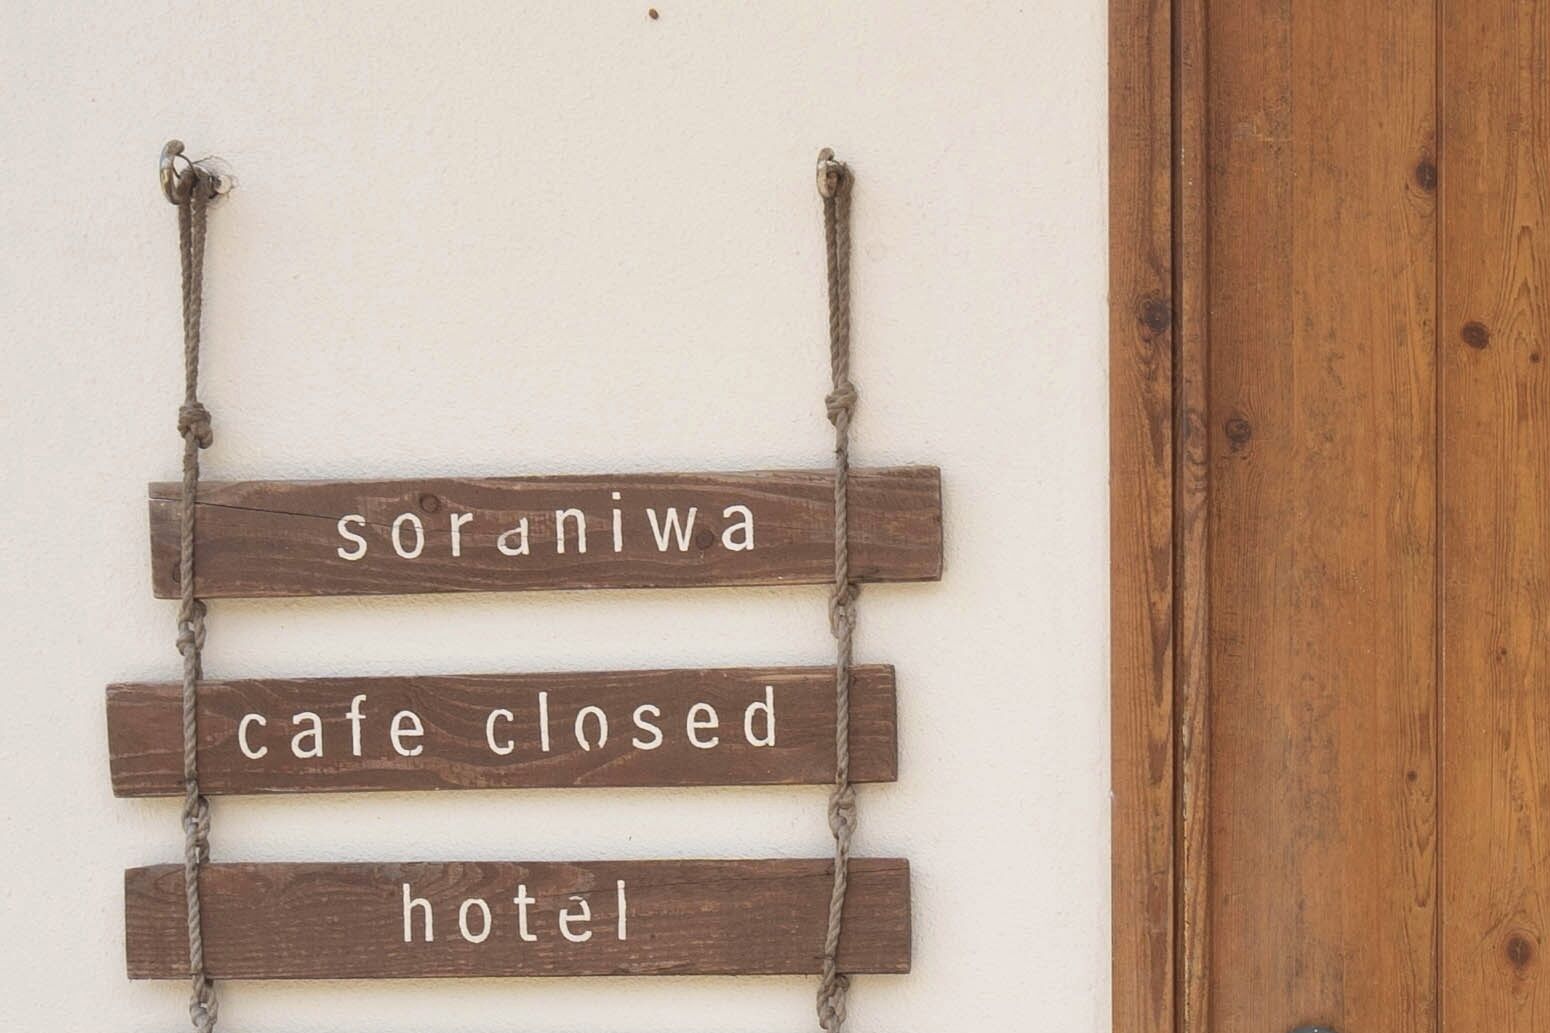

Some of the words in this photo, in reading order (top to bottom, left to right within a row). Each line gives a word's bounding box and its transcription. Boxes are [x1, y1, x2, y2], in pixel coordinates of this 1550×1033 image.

[337, 491, 754, 561] soraniwa
[238, 694, 424, 760] cafe
[486, 685, 776, 756] closed
[402, 879, 627, 944] hotel
